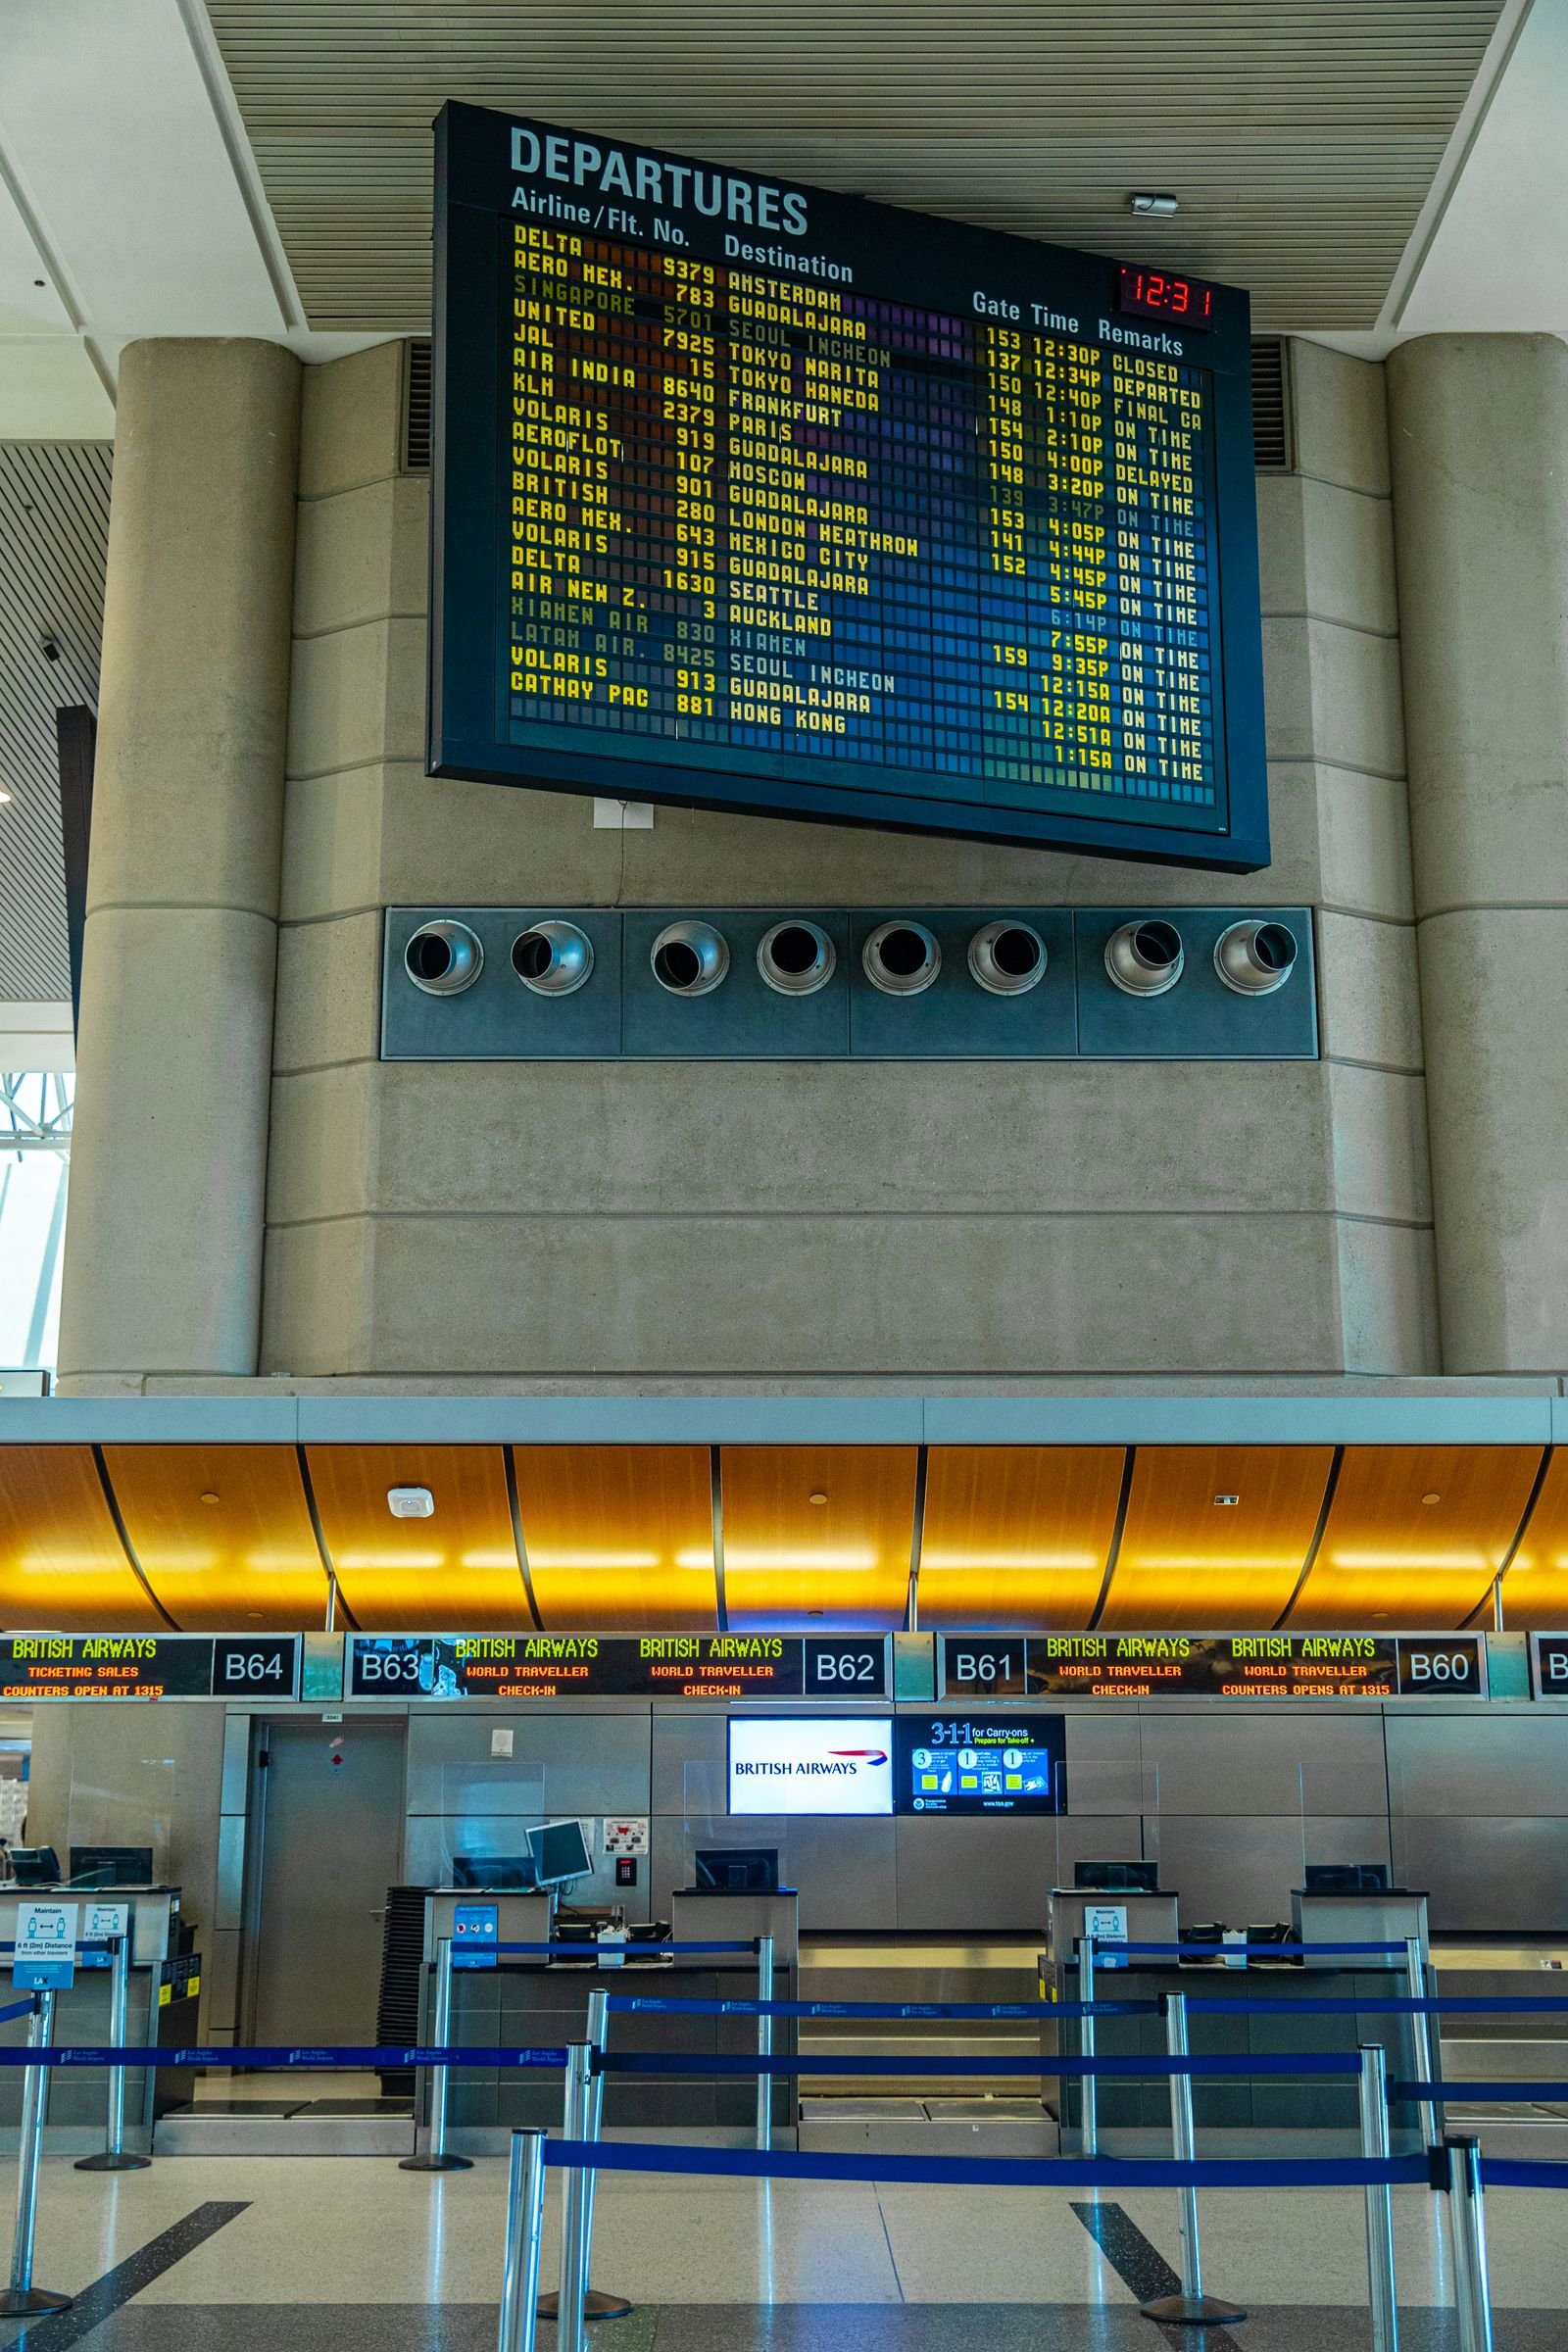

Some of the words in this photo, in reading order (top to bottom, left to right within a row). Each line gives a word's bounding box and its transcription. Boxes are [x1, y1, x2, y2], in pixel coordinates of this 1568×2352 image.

[511, 126, 808, 235] DEPARTURES
[654, 218, 689, 246] No.
[724, 234, 853, 283] Destination
[972, 291, 1020, 319] Gate
[1030, 303, 1079, 333] Time
[1099, 318, 1183, 357] Remarks
[1135, 273, 1210, 316] 12:31
[514, 224, 581, 257] DELTA
[728, 270, 840, 312] AMSTERDAM
[987, 326, 1020, 350] 153
[1034, 336, 1100, 367] 12:30P
[1112, 353, 1177, 383] CLOSED
[514, 248, 567, 277] AERO
[583, 263, 631, 291] MEX.
[676, 283, 713, 309] 783
[729, 294, 865, 340] GUADALAJARA
[987, 349, 1020, 372] 137
[1034, 359, 1101, 389] 12:34P
[1113, 375, 1200, 410] DEPARTED
[514, 297, 595, 331] UNITED
[663, 327, 713, 356] 7925
[729, 341, 791, 371] TOKYO
[806, 357, 878, 389] NARITA
[988, 394, 1021, 417] 148
[1048, 406, 1102, 433] 1:10P
[1114, 419, 1135, 440] ON
[1148, 426, 1191, 451] TIME
[514, 321, 553, 348] JAL
[690, 357, 713, 379] 15
[729, 365, 791, 395] TOKYO
[806, 380, 878, 412] HANEDA
[989, 416, 1022, 440] 154
[1047, 427, 1102, 455] 2:10P
[1115, 441, 1136, 462] ON
[1149, 448, 1192, 472] TIME
[988, 371, 1021, 395] 150
[1035, 381, 1101, 411] 12:40P
[1114, 397, 1167, 424] FINAL
[1181, 411, 1200, 431] CA
[514, 346, 553, 372] AIR
[572, 358, 634, 388] INDIA
[663, 375, 713, 403] 8640
[729, 389, 841, 427] FRANKFURT
[989, 439, 1022, 462] 150
[1047, 450, 1102, 477] 4:00P
[1115, 464, 1193, 494] DELAYED
[514, 371, 553, 397] KLM
[663, 400, 713, 427] 2379
[729, 413, 791, 441] PARIS
[990, 462, 1023, 484] 148
[1049, 472, 1103, 500] 3:20P
[1116, 485, 1138, 506] ON
[1151, 492, 1193, 515] TIME
[513, 420, 620, 458] AEROFLOT
[677, 450, 713, 475] 107
[730, 460, 805, 491] MOSCOW
[991, 507, 1024, 529] 153
[1049, 517, 1104, 544] 4:05P
[513, 470, 608, 505] BRITISH
[676, 499, 714, 523] 280
[729, 508, 805, 538] LONDON
[819, 523, 917, 557] HEATHROW
[992, 553, 1025, 575] 152
[1050, 563, 1106, 589] 4:45P
[513, 495, 565, 522] AERO
[582, 507, 631, 533] MEX.
[676, 522, 713, 547] 643
[729, 531, 805, 562] MEXICO
[819, 547, 868, 572] CITY
[1050, 585, 1106, 611] 5:45P
[1120, 597, 1141, 616] ON
[1153, 602, 1197, 625] TIME
[512, 570, 551, 595] AIR
[567, 578, 607, 603] NEW
[622, 587, 644, 609] Z.
[704, 600, 714, 619] 3
[730, 604, 831, 637] AUCKLAND
[994, 644, 1026, 666] 159
[1052, 653, 1108, 678] 9:35P
[1121, 663, 1143, 683] ON
[1155, 668, 1199, 692] TIME
[511, 671, 592, 700] CATHAY
[609, 684, 648, 708] PAC
[677, 693, 711, 716] 881
[730, 701, 780, 725] HONG
[796, 710, 845, 734] KONG
[1054, 744, 1111, 769] 1:15A
[1124, 754, 1146, 773] ON
[1158, 759, 1202, 781] TIME
[12, 1639, 73, 1658] BRITISH
[82, 1639, 157, 1658] AIRWAYS
[455, 1639, 515, 1658] BRITISH
[524, 1639, 599, 1658] AIRWAYS
[640, 1639, 700, 1658] BRITISH
[710, 1639, 783, 1658] AIRWAYS
[1047, 1638, 1106, 1657] BRITISH
[1116, 1638, 1190, 1657] AIRWAYS
[1232, 1638, 1292, 1657] BRITISH
[1301, 1638, 1375, 1657] AIRWAYS
[27, 1667, 92, 1678] TICKETING
[97, 1667, 139, 1678] SALES
[225, 1653, 283, 1680] B64
[362, 1654, 418, 1680] B63
[466, 1666, 509, 1677] WORLD
[514, 1666, 589, 1677] TRAVELLER
[651, 1666, 694, 1677] WORLD
[700, 1666, 773, 1677] TRAVELLER
[816, 1654, 874, 1681] B62
[956, 1654, 1010, 1681] B61
[1058, 1666, 1102, 1677] WORLD
[1107, 1666, 1182, 1677] TRAVELLER
[1244, 1666, 1287, 1677] WORLD
[1292, 1666, 1367, 1677] TRAVELLER
[1410, 1653, 1470, 1680] B60
[3, 1686, 69, 1696] COUNTERS
[74, 1686, 107, 1696] OPEN
[113, 1686, 129, 1696] AT
[134, 1686, 164, 1696] 1315
[498, 1685, 557, 1695] CHECK-IN
[683, 1685, 742, 1695] CHECK-IN
[1092, 1685, 1150, 1695] CHECK-IN
[1222, 1685, 1288, 1695] COUNTERS
[1293, 1685, 1335, 1695] OPENS
[1339, 1685, 1355, 1695] AT
[1361, 1685, 1391, 1695] 1315
[931, 1722, 973, 1744] 3-1-1
[972, 1727, 985, 1737] for
[986, 1728, 1028, 1739] Carry-ons
[735, 1762, 792, 1775] BRITISH
[796, 1762, 858, 1775] AIRWAYS
[917, 1751, 926, 1765] 3
